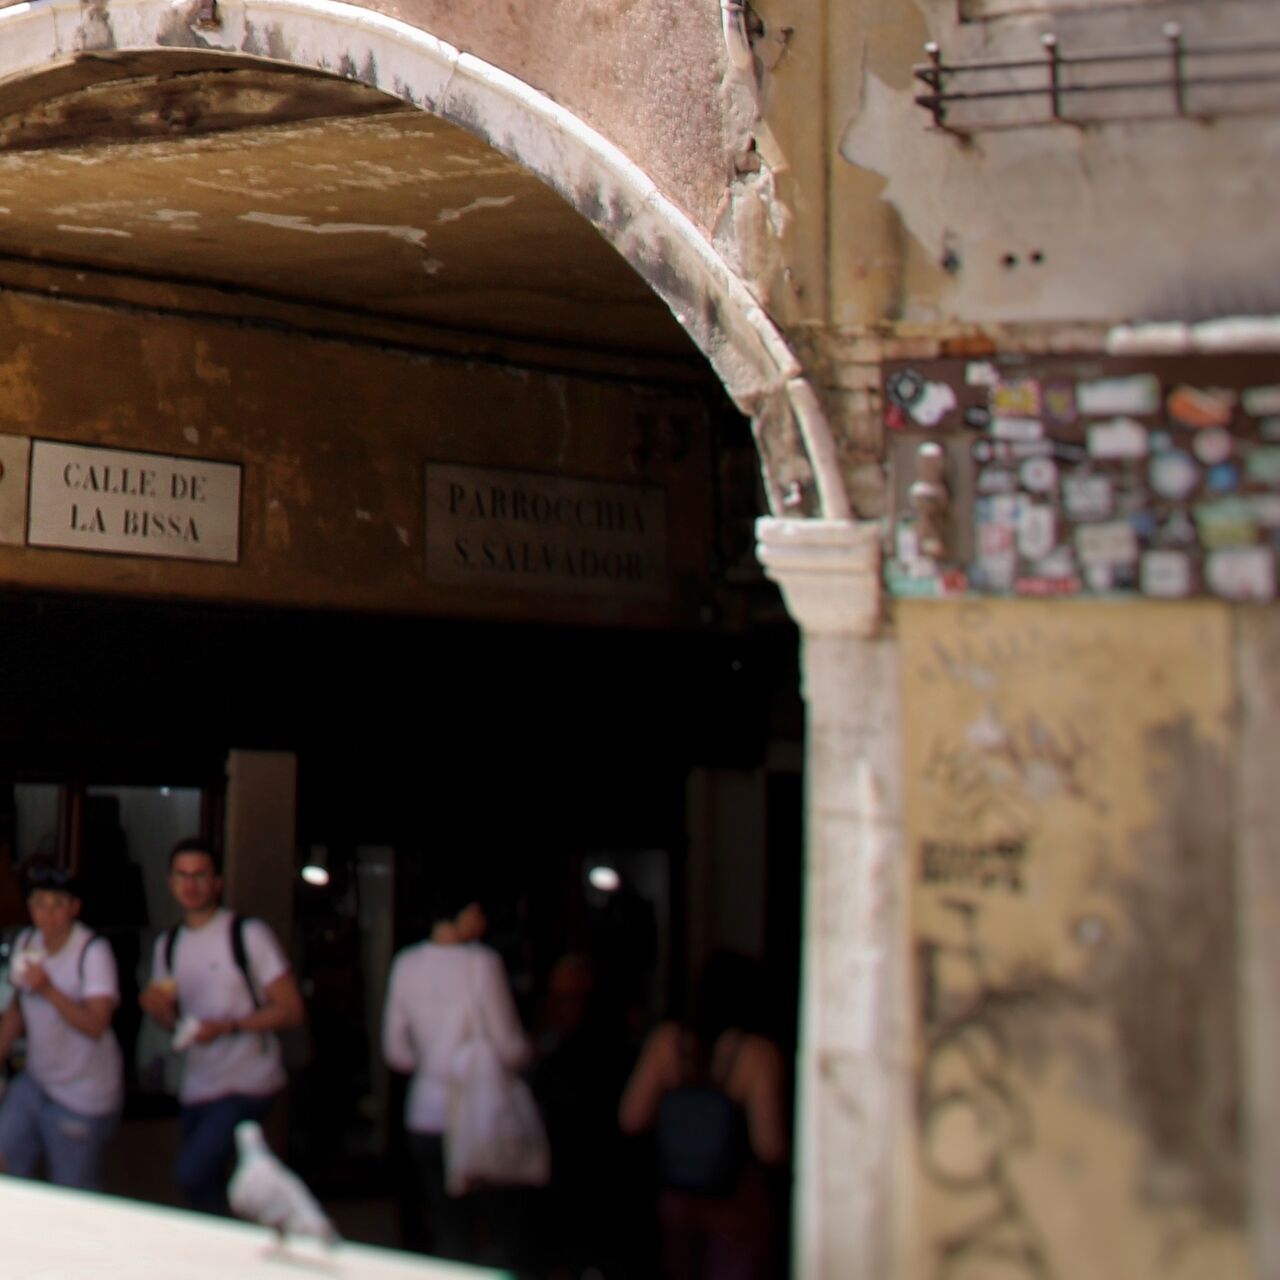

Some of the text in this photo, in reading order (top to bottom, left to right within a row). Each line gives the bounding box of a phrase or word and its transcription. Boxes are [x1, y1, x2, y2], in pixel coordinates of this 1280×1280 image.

[62, 461, 208, 503] CALLE DE
[70, 502, 200, 543] LA BISSA
[448, 483, 646, 533] PARROCCHIA
